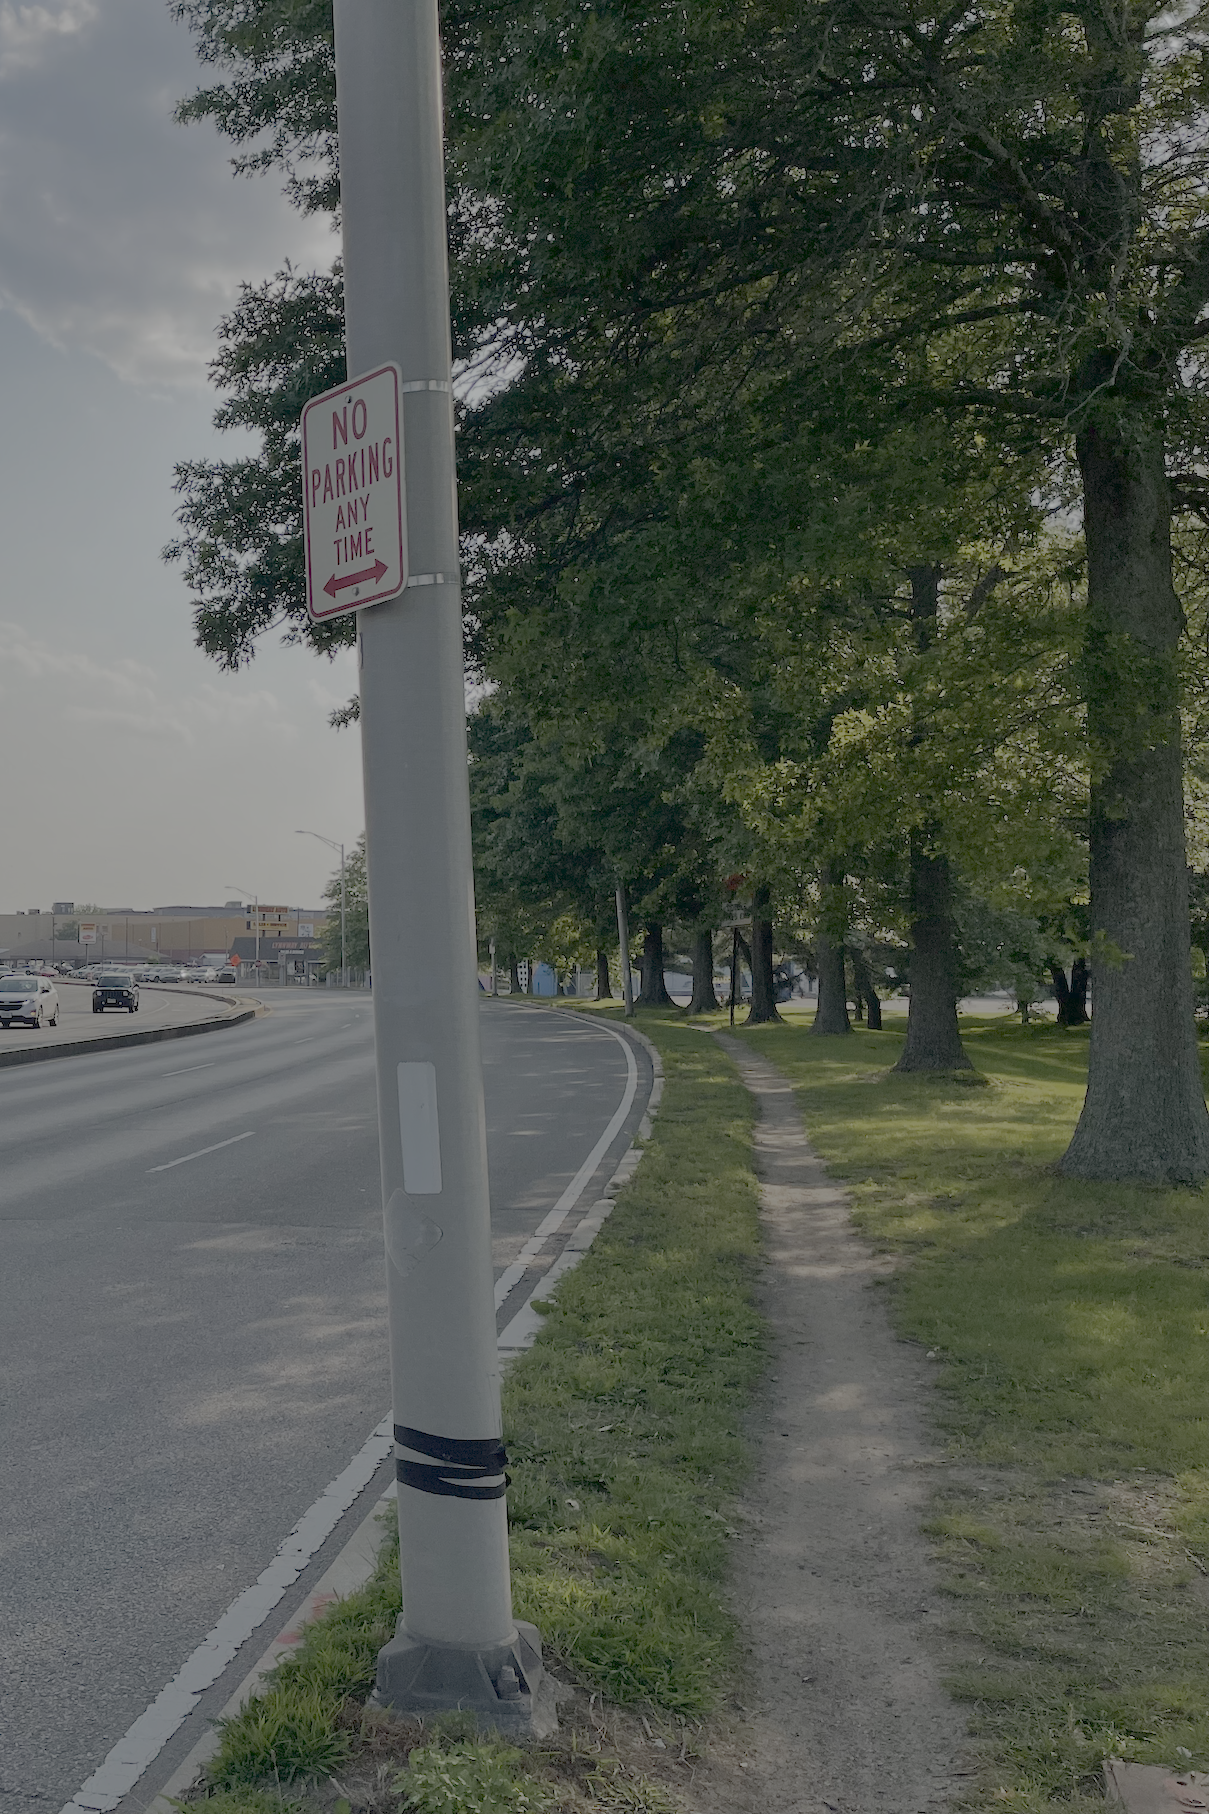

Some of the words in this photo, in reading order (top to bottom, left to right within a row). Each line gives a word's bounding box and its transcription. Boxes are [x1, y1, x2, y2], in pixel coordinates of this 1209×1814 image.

[332, 398, 368, 450] NO
[311, 437, 393, 508] PARKING
[335, 493, 370, 533] ANY
[333, 526, 375, 566] TIME
